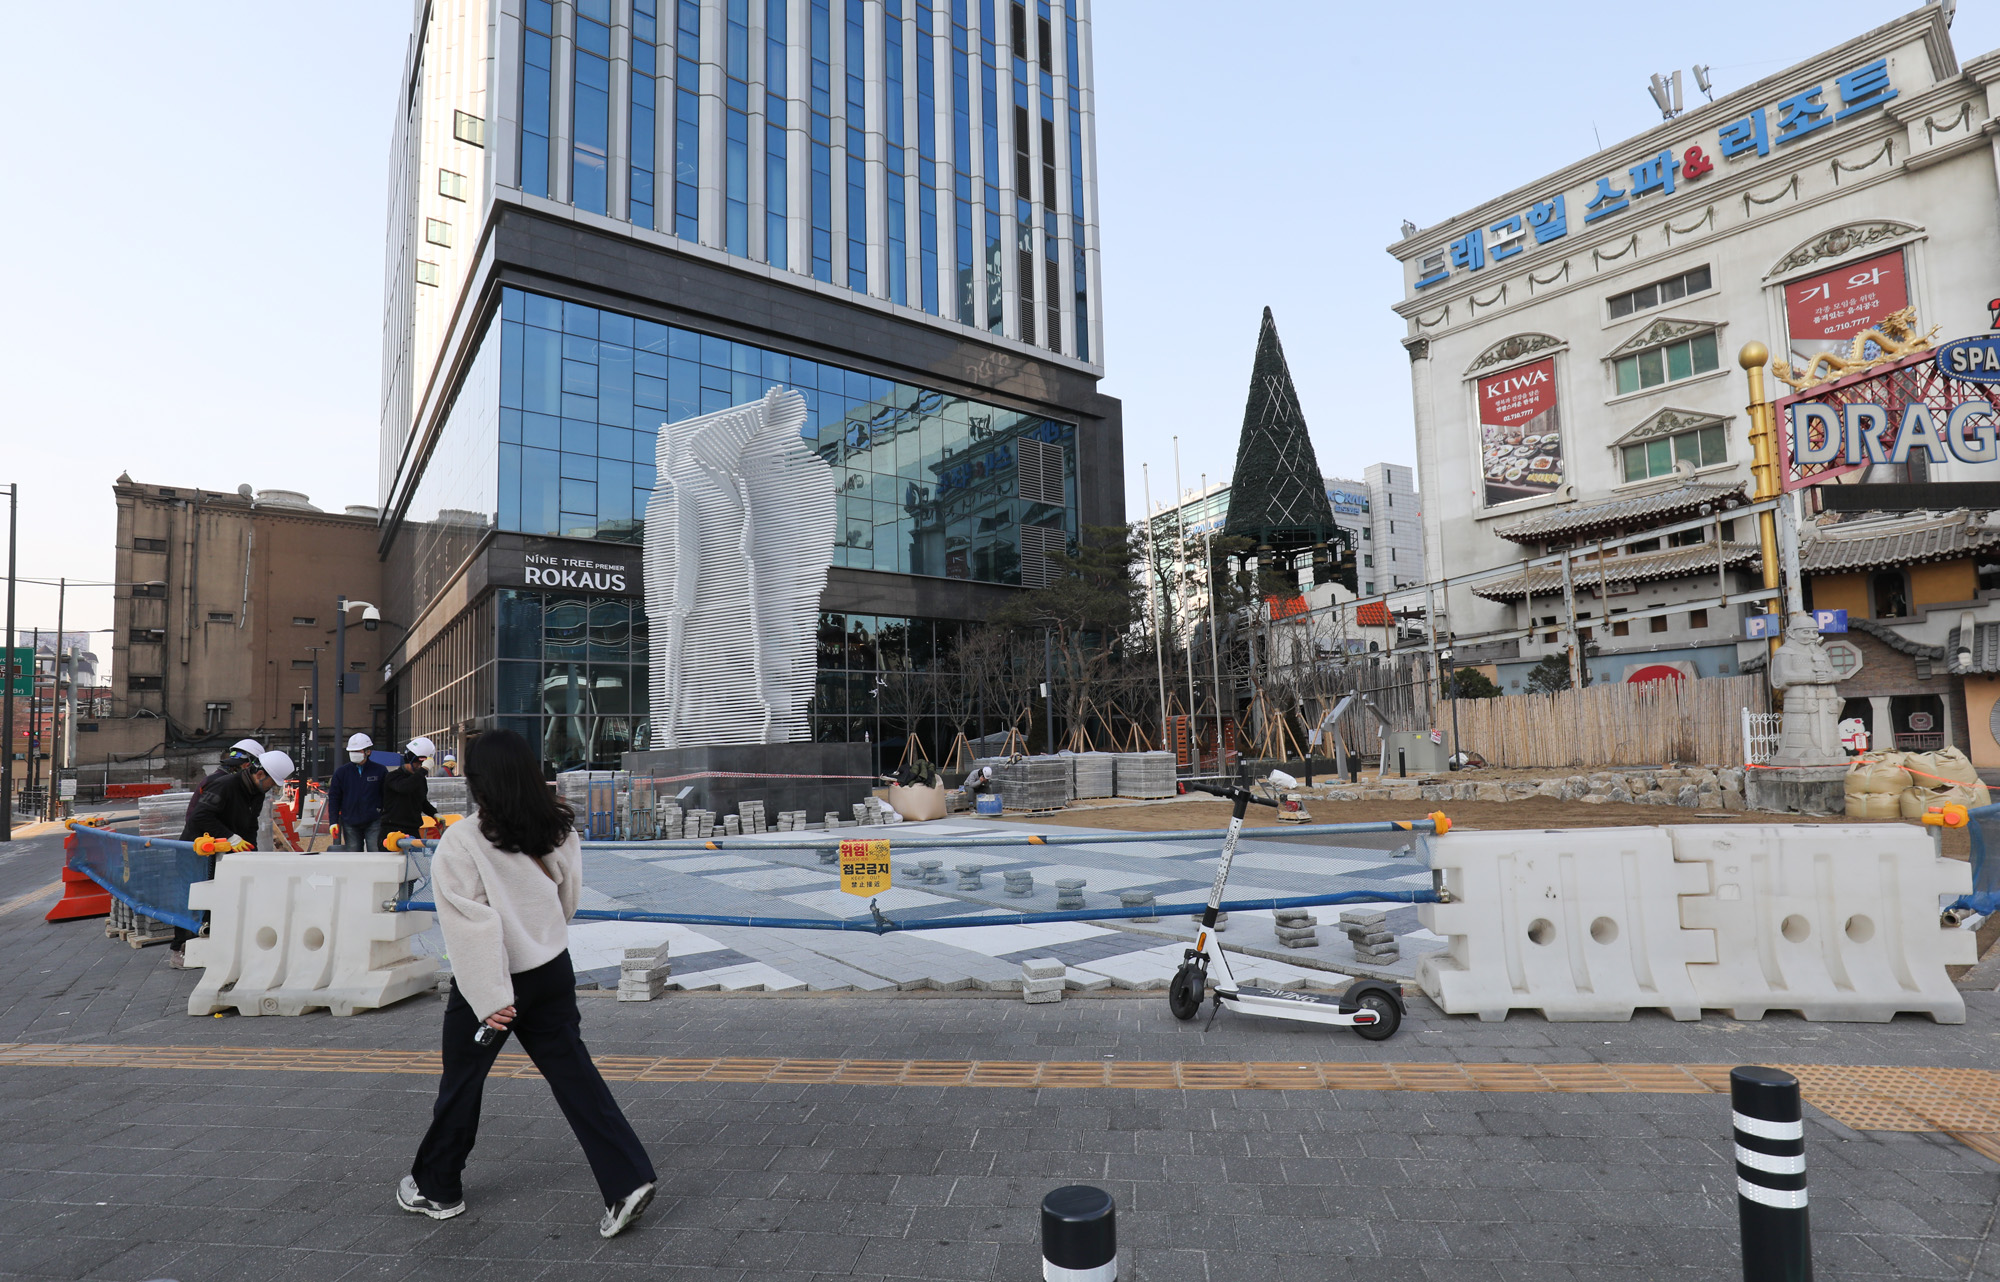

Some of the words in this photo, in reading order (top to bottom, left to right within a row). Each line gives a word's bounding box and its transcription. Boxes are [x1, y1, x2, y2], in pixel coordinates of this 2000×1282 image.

[1414, 194, 1568, 290] 드래곤힐
[1833, 297, 1858, 311] 모임을
[1859, 291, 1876, 303] 위한
[1824, 316, 1871, 335] 02.710.7777
[1486, 369, 1550, 399] KIWA
[562, 558, 594, 569] TREE
[595, 563, 625, 572] PREMIER
[525, 566, 626, 592] ROKAUS
[1751, 618, 1765, 636] P
[1818, 612, 1834, 630] P
[841, 843, 869, 857] 위험!
[843, 863, 889, 875] 접근금지
